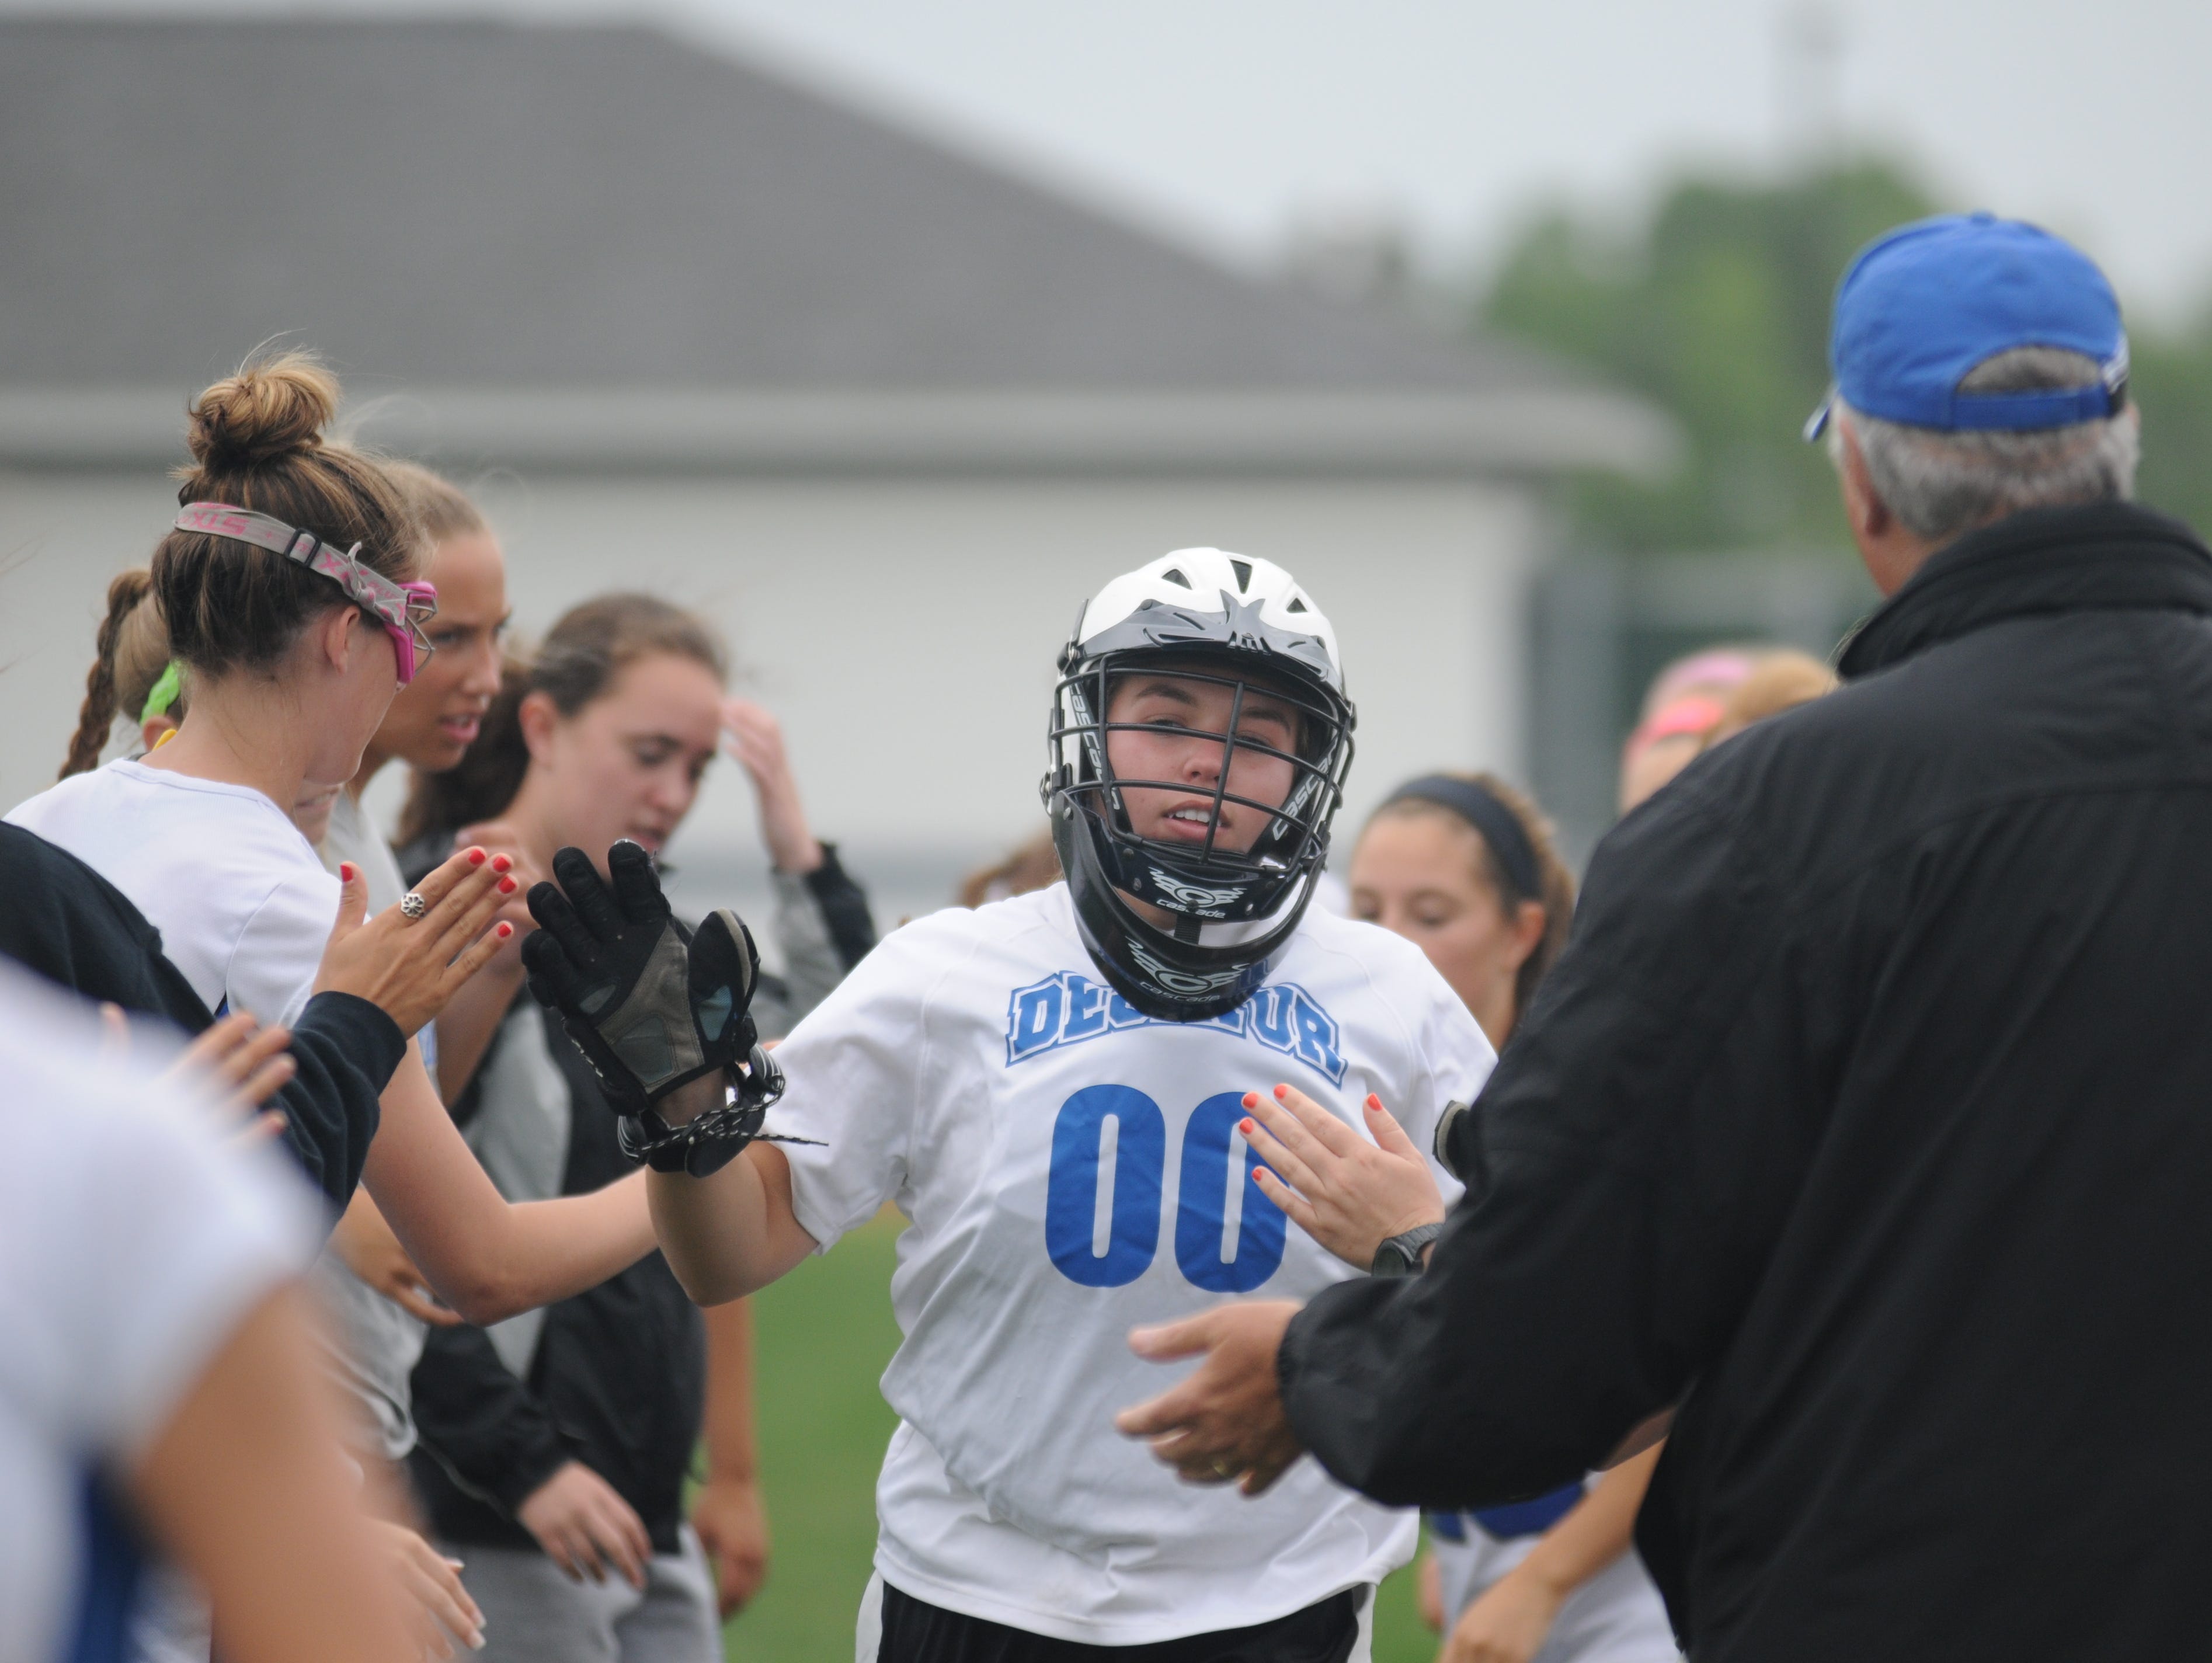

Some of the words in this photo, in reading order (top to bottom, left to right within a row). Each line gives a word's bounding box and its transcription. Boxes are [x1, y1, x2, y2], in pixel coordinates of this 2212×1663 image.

[1156, 899, 1226, 919] casade
[1139, 981, 1220, 1003] cascade
[1045, 1084, 1289, 1293] 00
